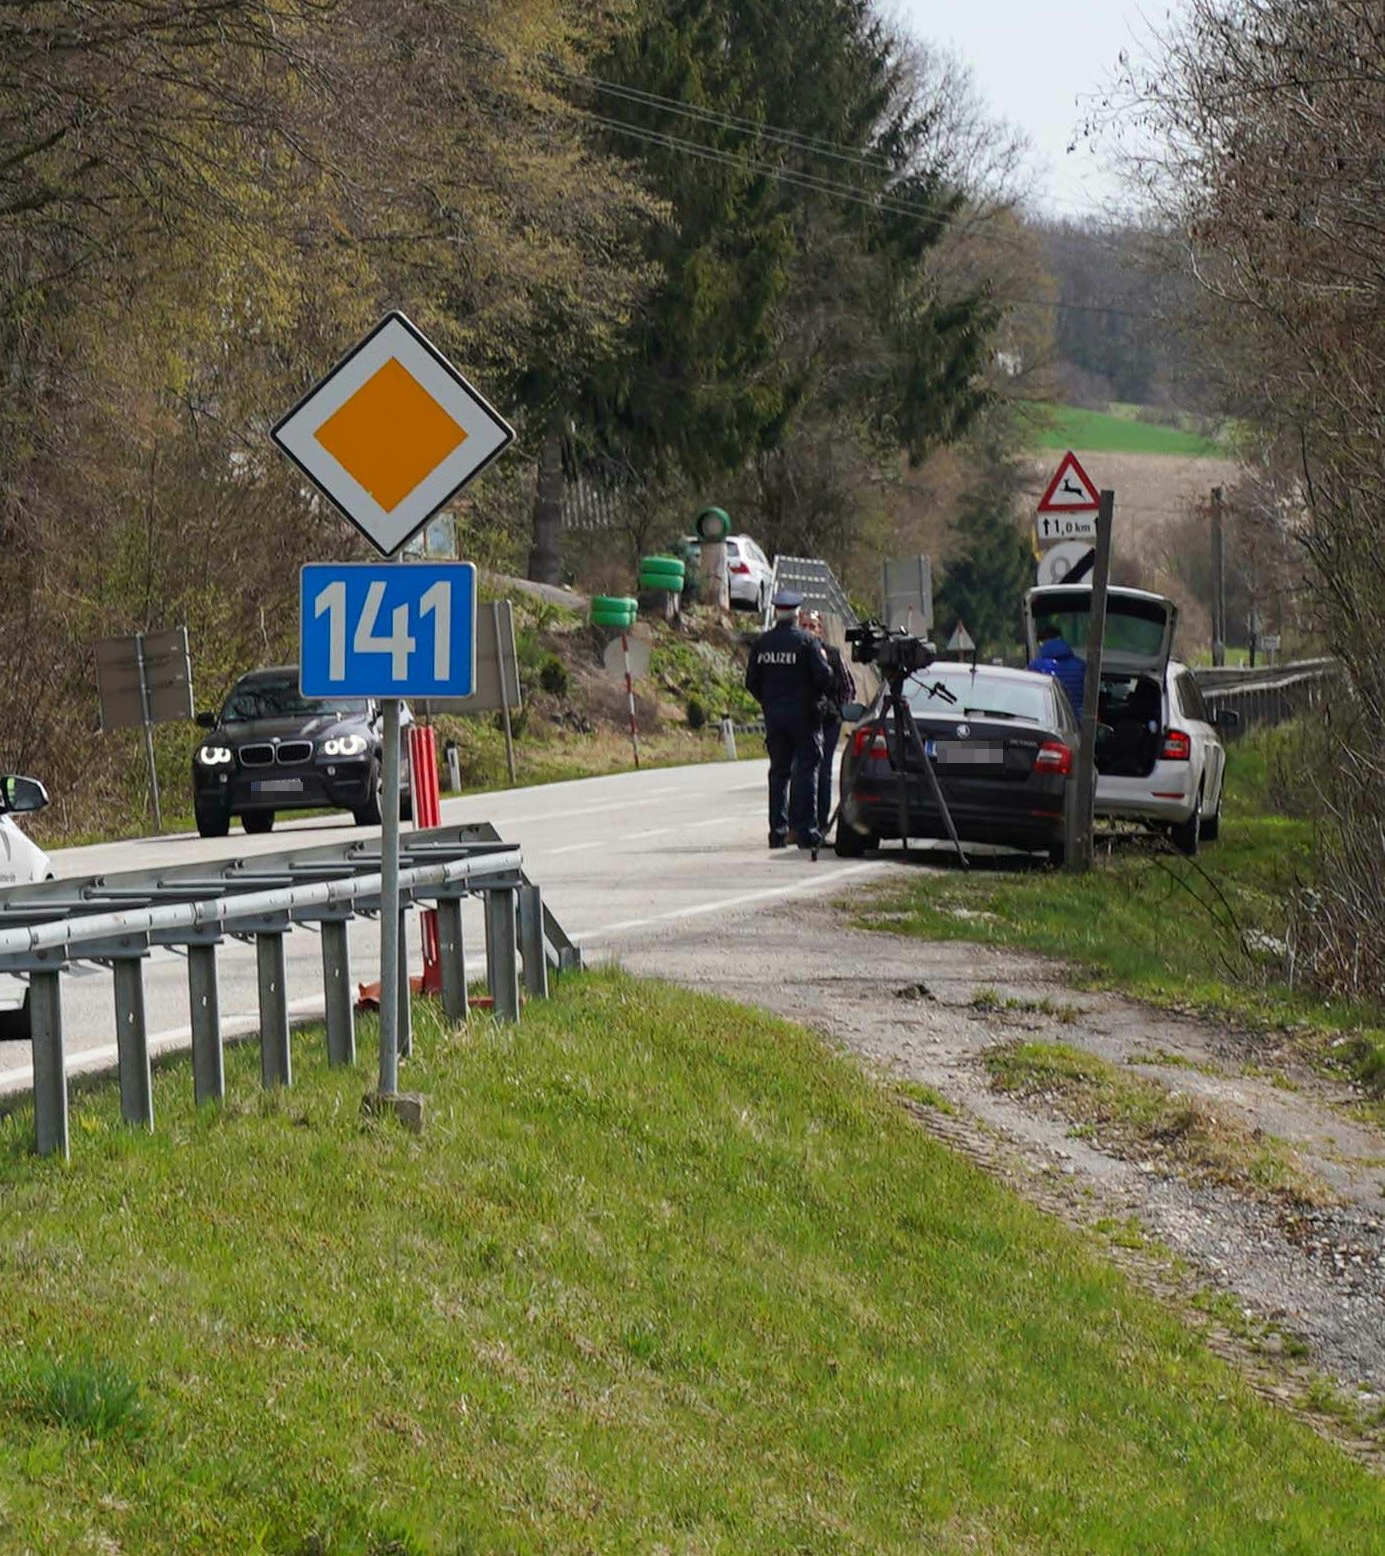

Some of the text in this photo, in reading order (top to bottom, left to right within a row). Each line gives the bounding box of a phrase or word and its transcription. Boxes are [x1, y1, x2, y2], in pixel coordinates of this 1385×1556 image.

[1055, 518, 1091, 536] 1,0 km
[314, 580, 452, 681] 141
[757, 651, 797, 664] POLIZEI
